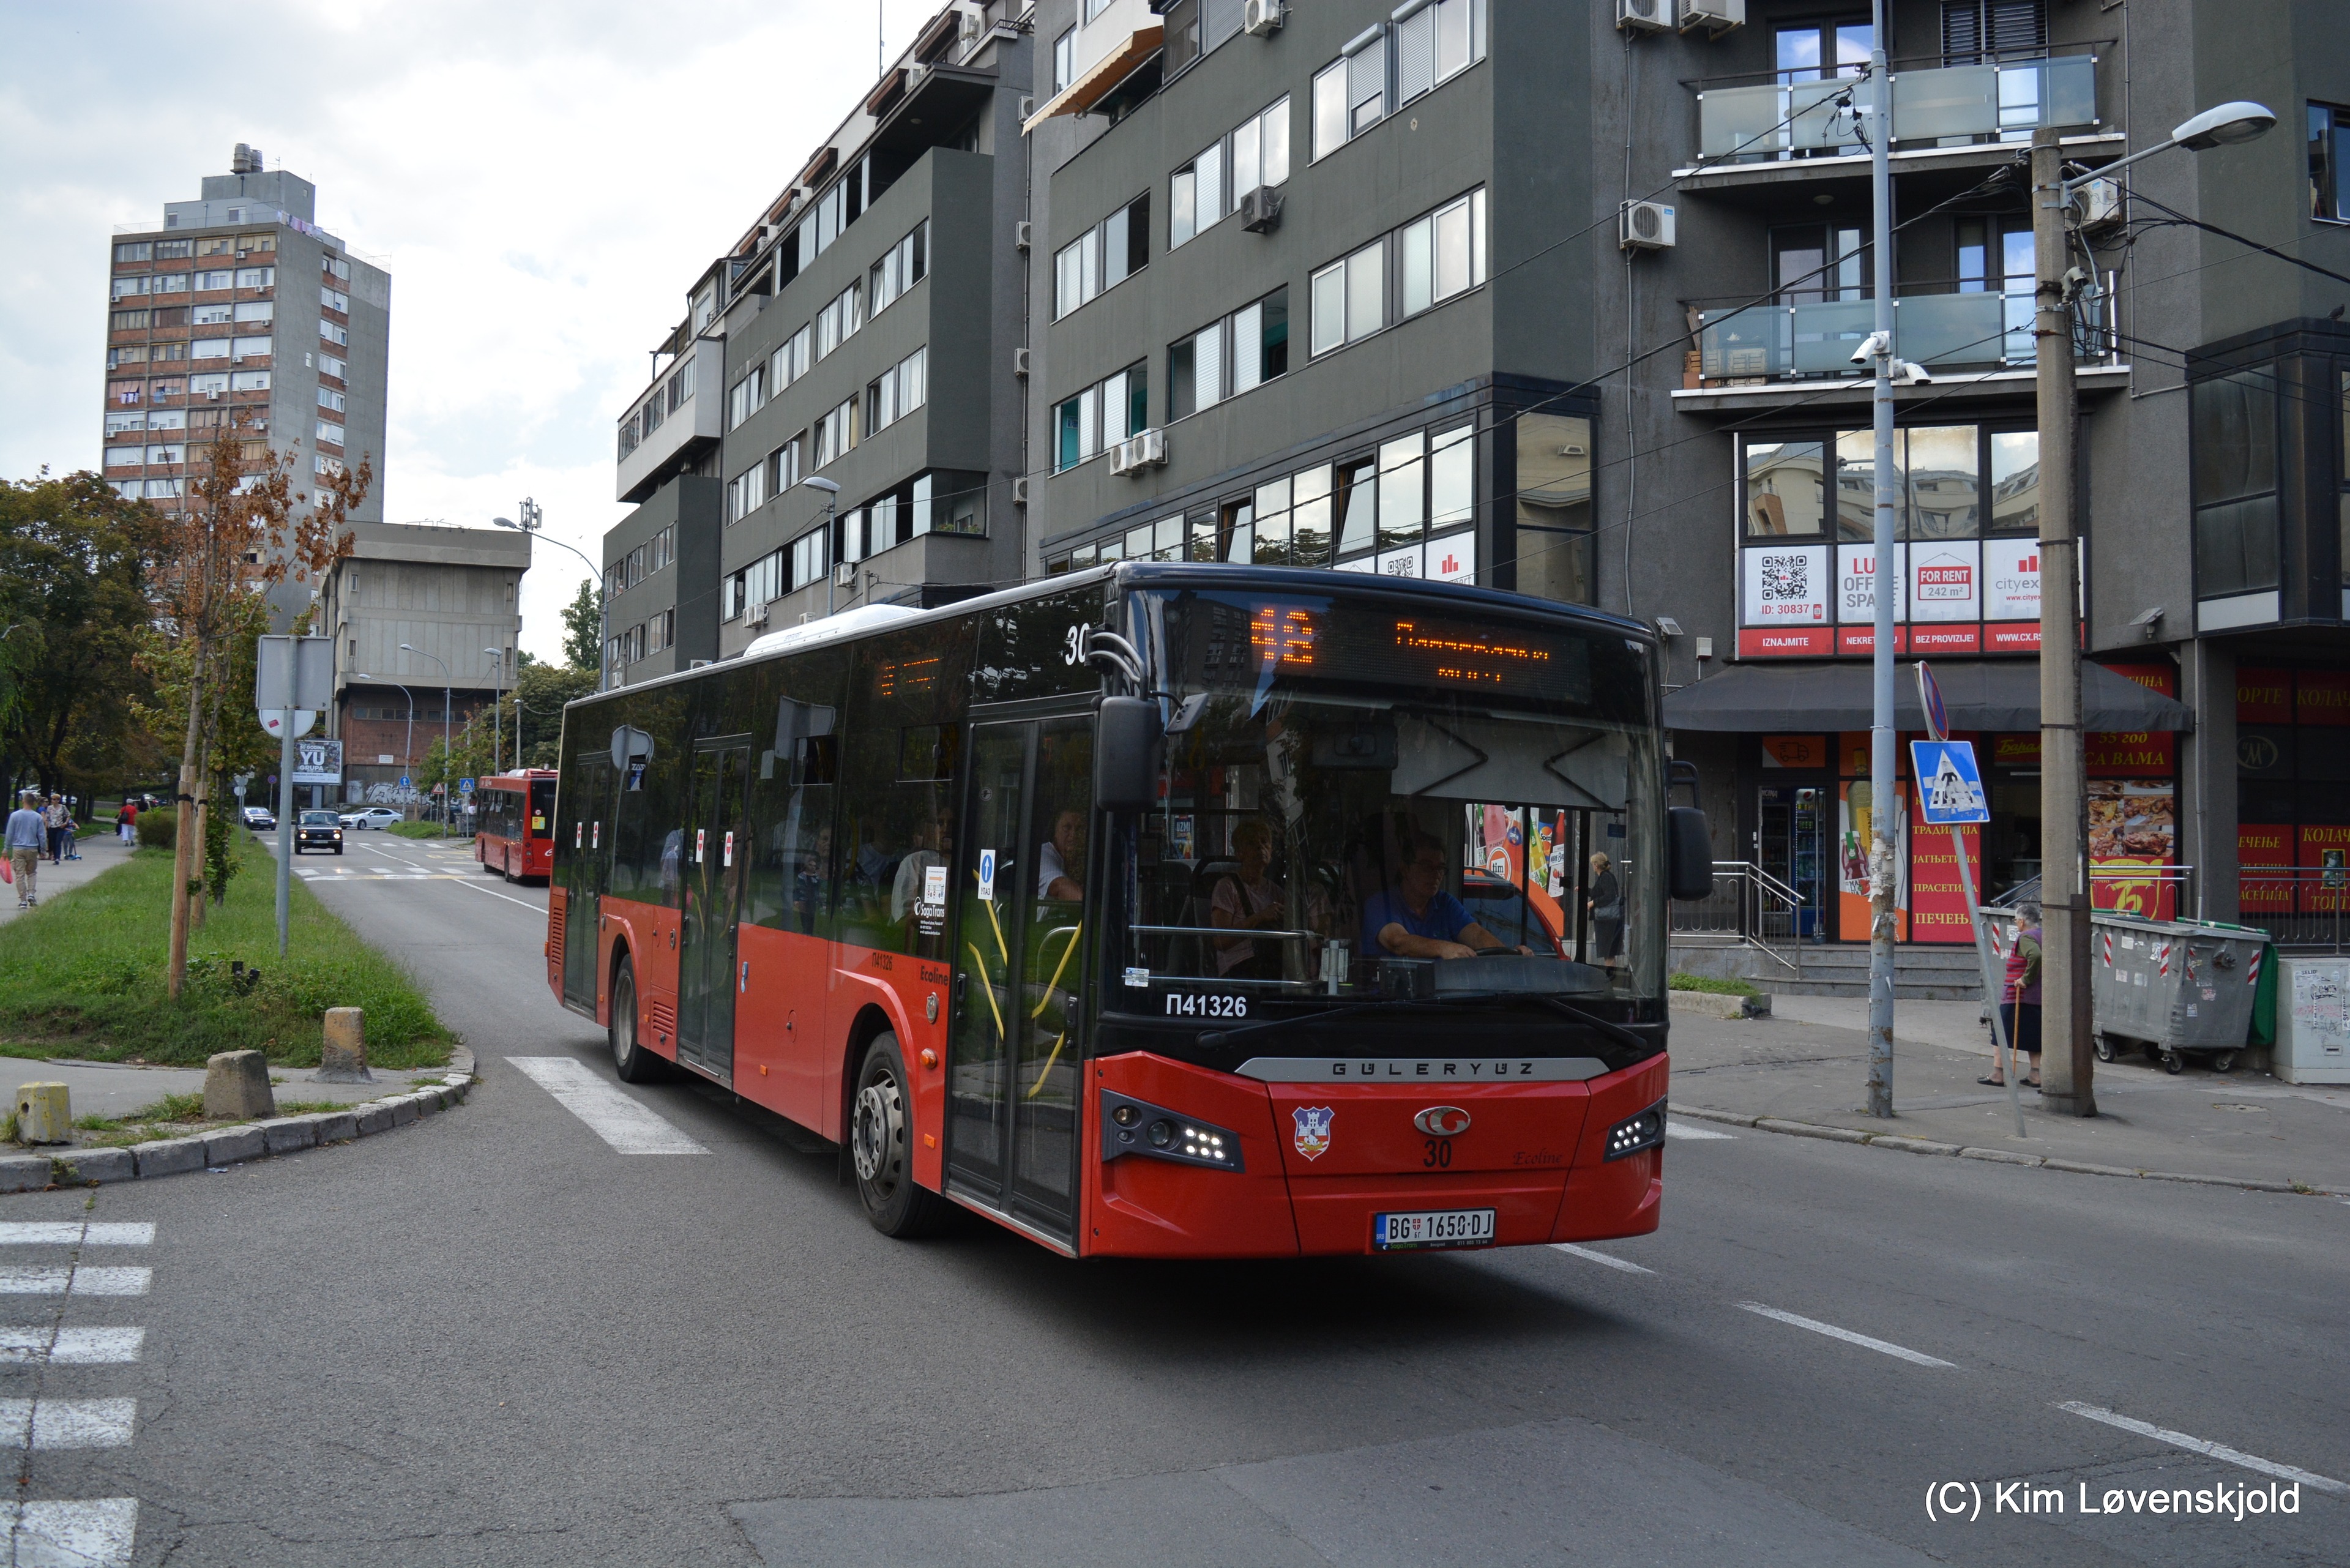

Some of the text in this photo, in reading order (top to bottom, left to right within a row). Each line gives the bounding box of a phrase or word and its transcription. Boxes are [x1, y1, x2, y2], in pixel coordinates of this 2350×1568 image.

[1853, 558, 1875, 574] LU
[1920, 570, 1969, 582] FOR RENT
[1928, 588, 1947, 596] 242
[1762, 604, 1810, 614] ID: 30837
[1762, 638, 1809, 647] IZNAJMITE
[1931, 634, 1974, 643] PROVIZIJE!
[2237, 687, 2283, 704] ОРТЕ
[300, 752, 325, 765] YU
[2113, 752, 2165, 765] ВАМА
[1176, 821, 1191, 832] UZMI
[1912, 826, 1978, 835] ТРАДИИЈА
[2238, 836, 2281, 848] ЕЧЕЊЕ
[1492, 862, 1504, 873] tim
[980, 887, 991, 895] УЛАЗ
[2239, 890, 2289, 900] АСЕТИНА
[920, 903, 945, 919] SagaTrans
[1915, 913, 1972, 924] ПЕЧЕЊ
[871, 952, 893, 971] П41326
[920, 965, 949, 987] Ecoline
[1166, 993, 1247, 1017] П41326
[1332, 1062, 1532, 1076] GÜLERYÜZ
[1423, 1139, 1452, 1168] 30
[1513, 1148, 1563, 1167] Ecoline
[1389, 1217, 1411, 1240] BG
